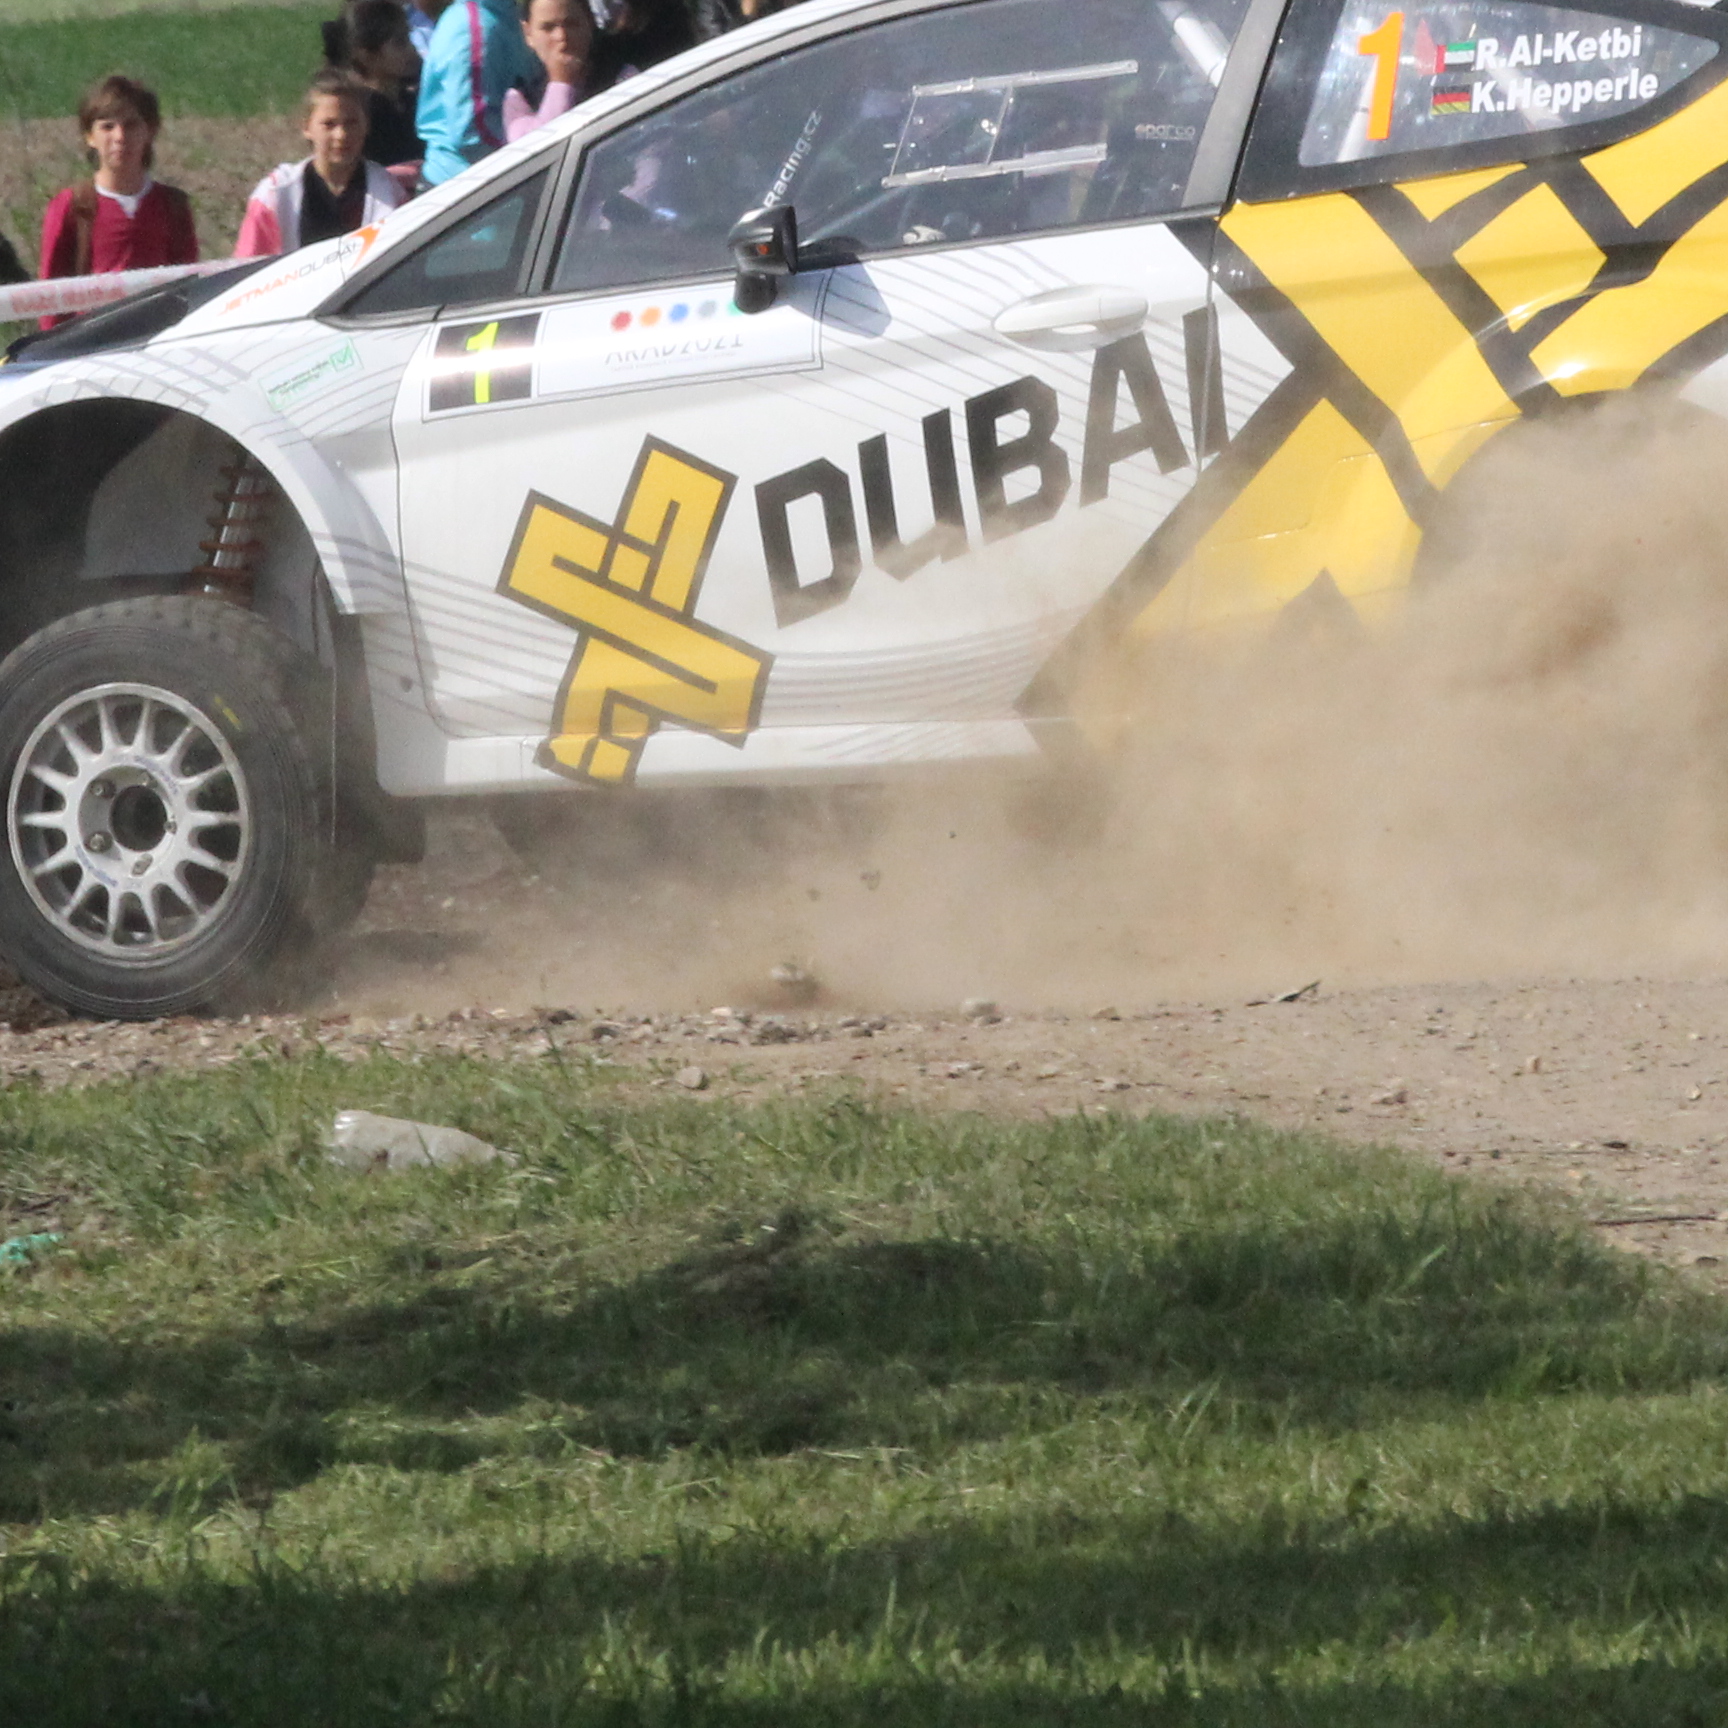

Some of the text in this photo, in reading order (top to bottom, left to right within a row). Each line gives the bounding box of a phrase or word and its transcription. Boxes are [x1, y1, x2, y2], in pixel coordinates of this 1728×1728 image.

[1358, 12, 1404, 140] 1
[1476, 26, 1642, 70] R.Al-Ketbi
[1471, 68, 1659, 113] K.Hepperle
[466, 322, 499, 403] 1
[754, 303, 1232, 629] DUBAI
